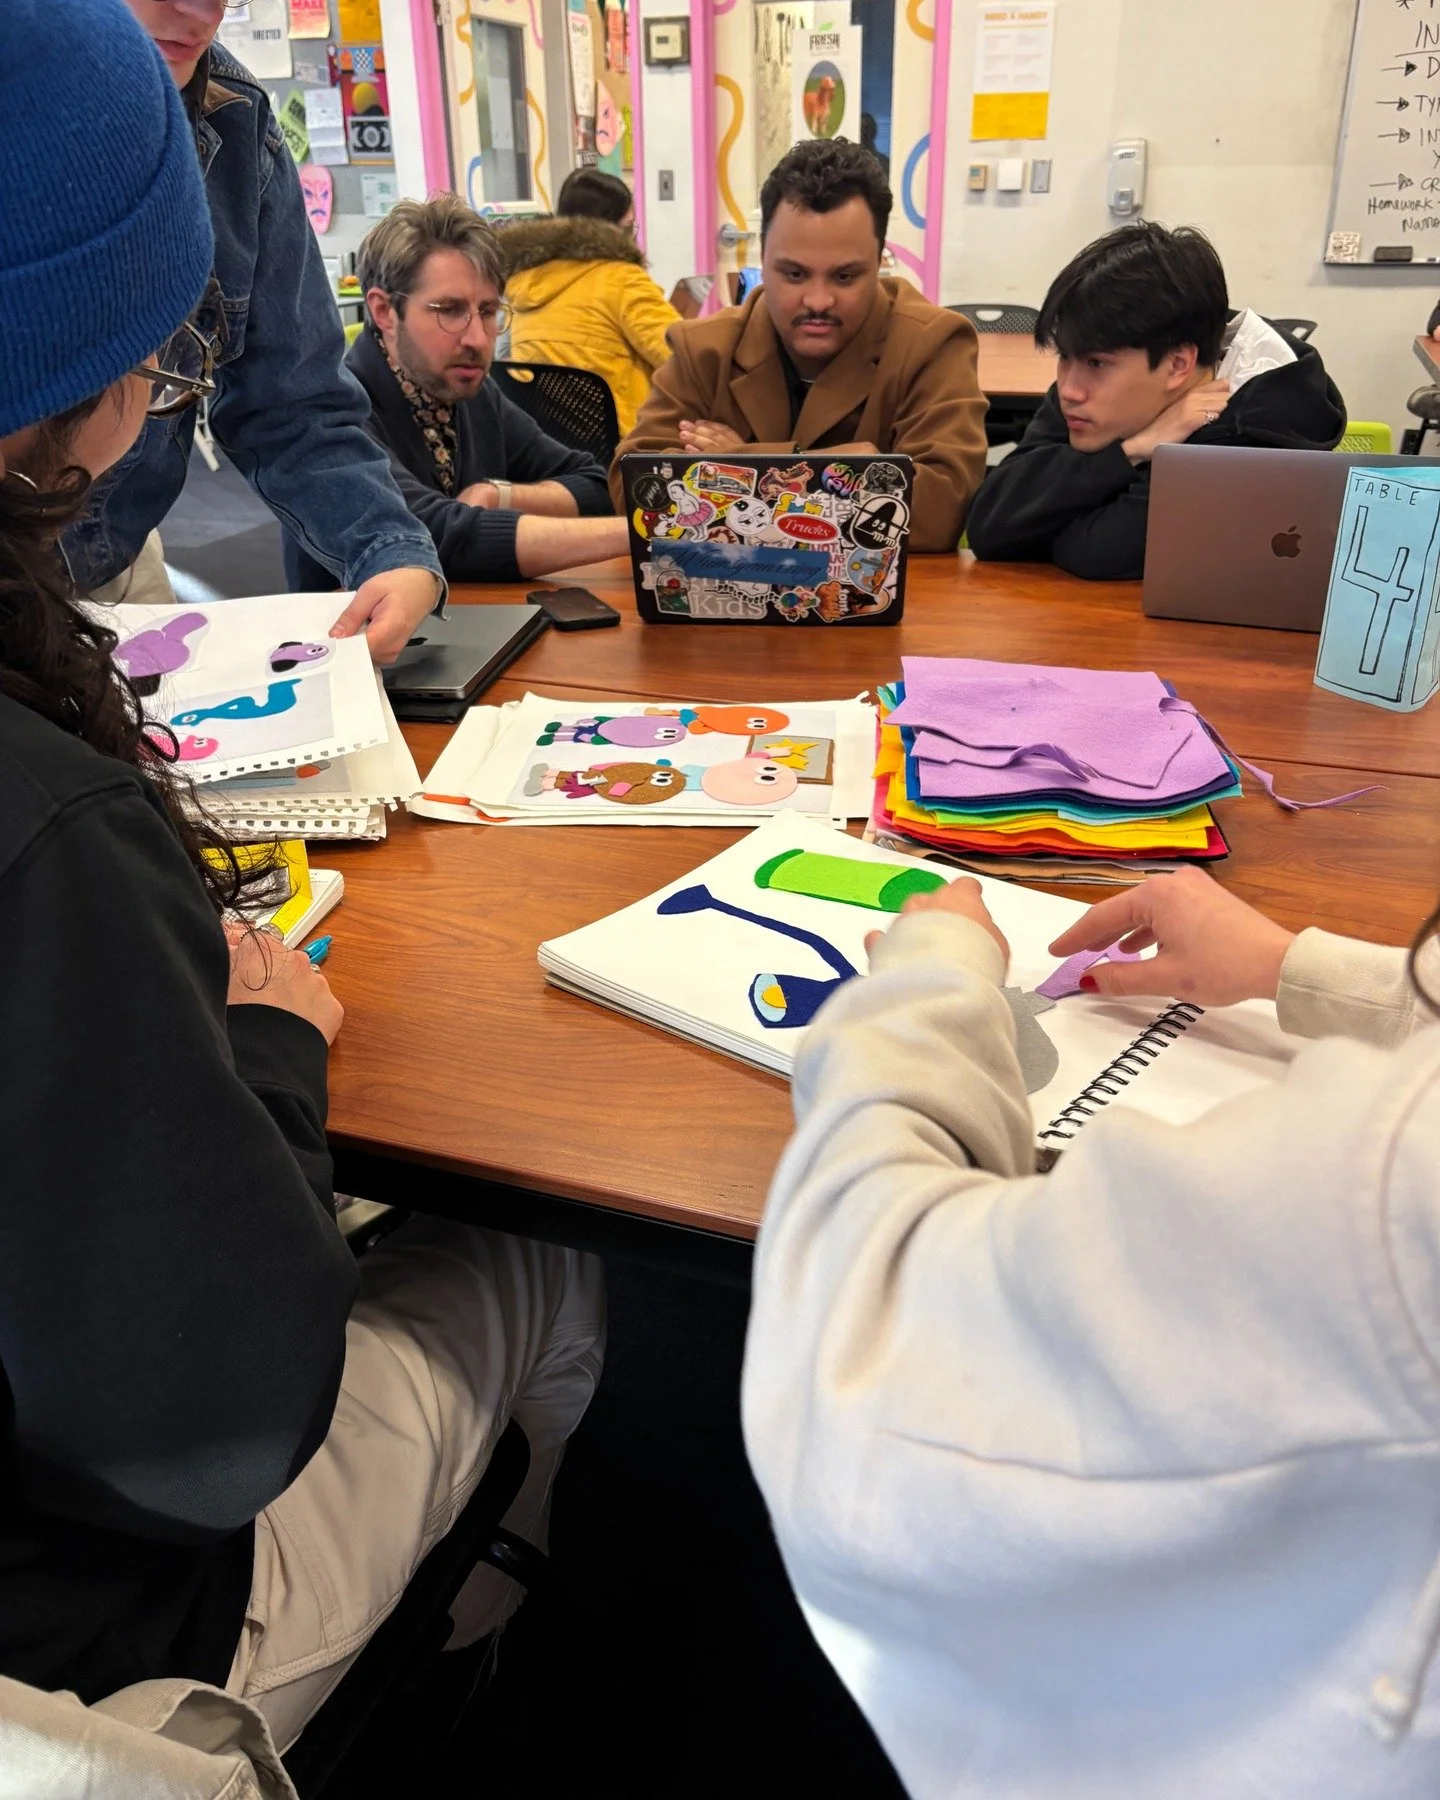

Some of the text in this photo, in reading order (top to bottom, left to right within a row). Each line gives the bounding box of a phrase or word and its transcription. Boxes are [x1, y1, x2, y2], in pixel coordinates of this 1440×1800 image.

[1354, 478, 1421, 506] TABLE
[784, 518, 831, 538] Trucks
[1341, 505, 1415, 675] 4
